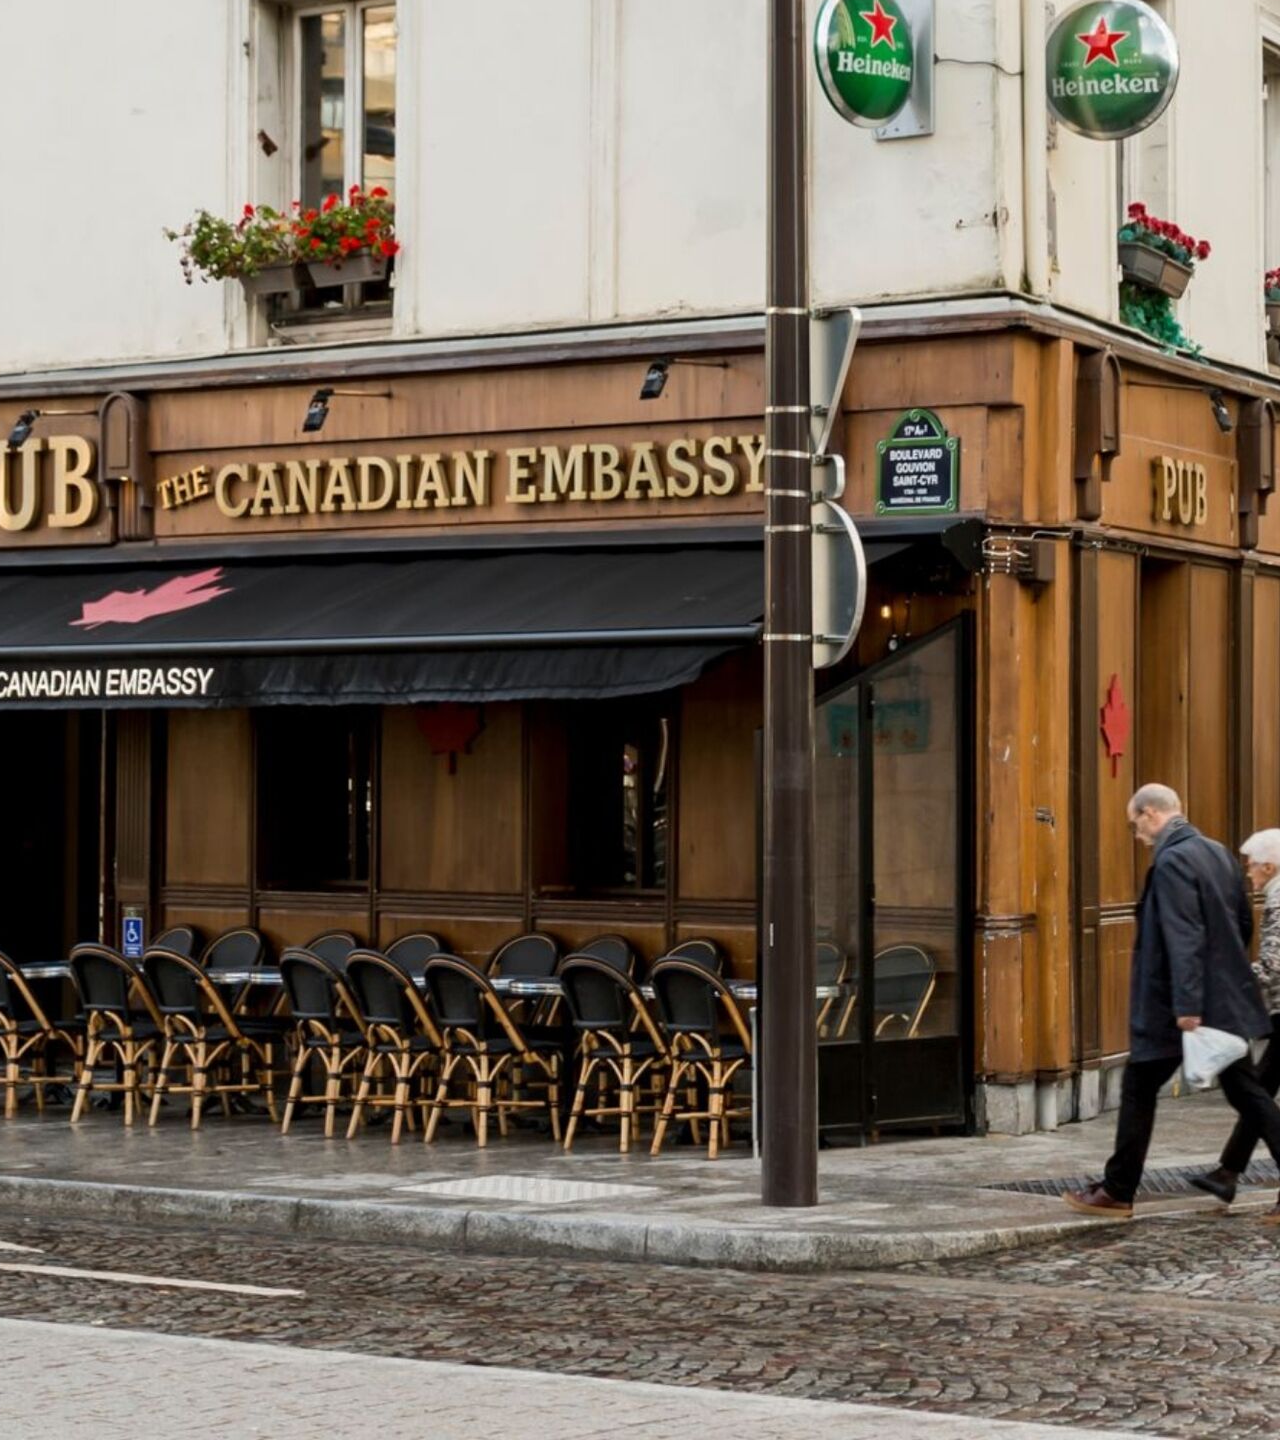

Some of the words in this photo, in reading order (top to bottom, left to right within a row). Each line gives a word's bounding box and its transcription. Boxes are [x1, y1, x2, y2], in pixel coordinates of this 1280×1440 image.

[837, 51, 911, 82] Heineken
[1051, 73, 1159, 98] Heineken
[889, 448, 943, 461] BOULEVARD
[895, 461, 936, 473] GOUVION
[156, 464, 210, 510] THE
[215, 449, 489, 518] CANADIAN
[505, 434, 766, 504] EMBASSY
[892, 474, 938, 487] SAINT-CYR
[1161, 455, 1208, 526] PUB
[105, 666, 214, 696] EMBASSY
